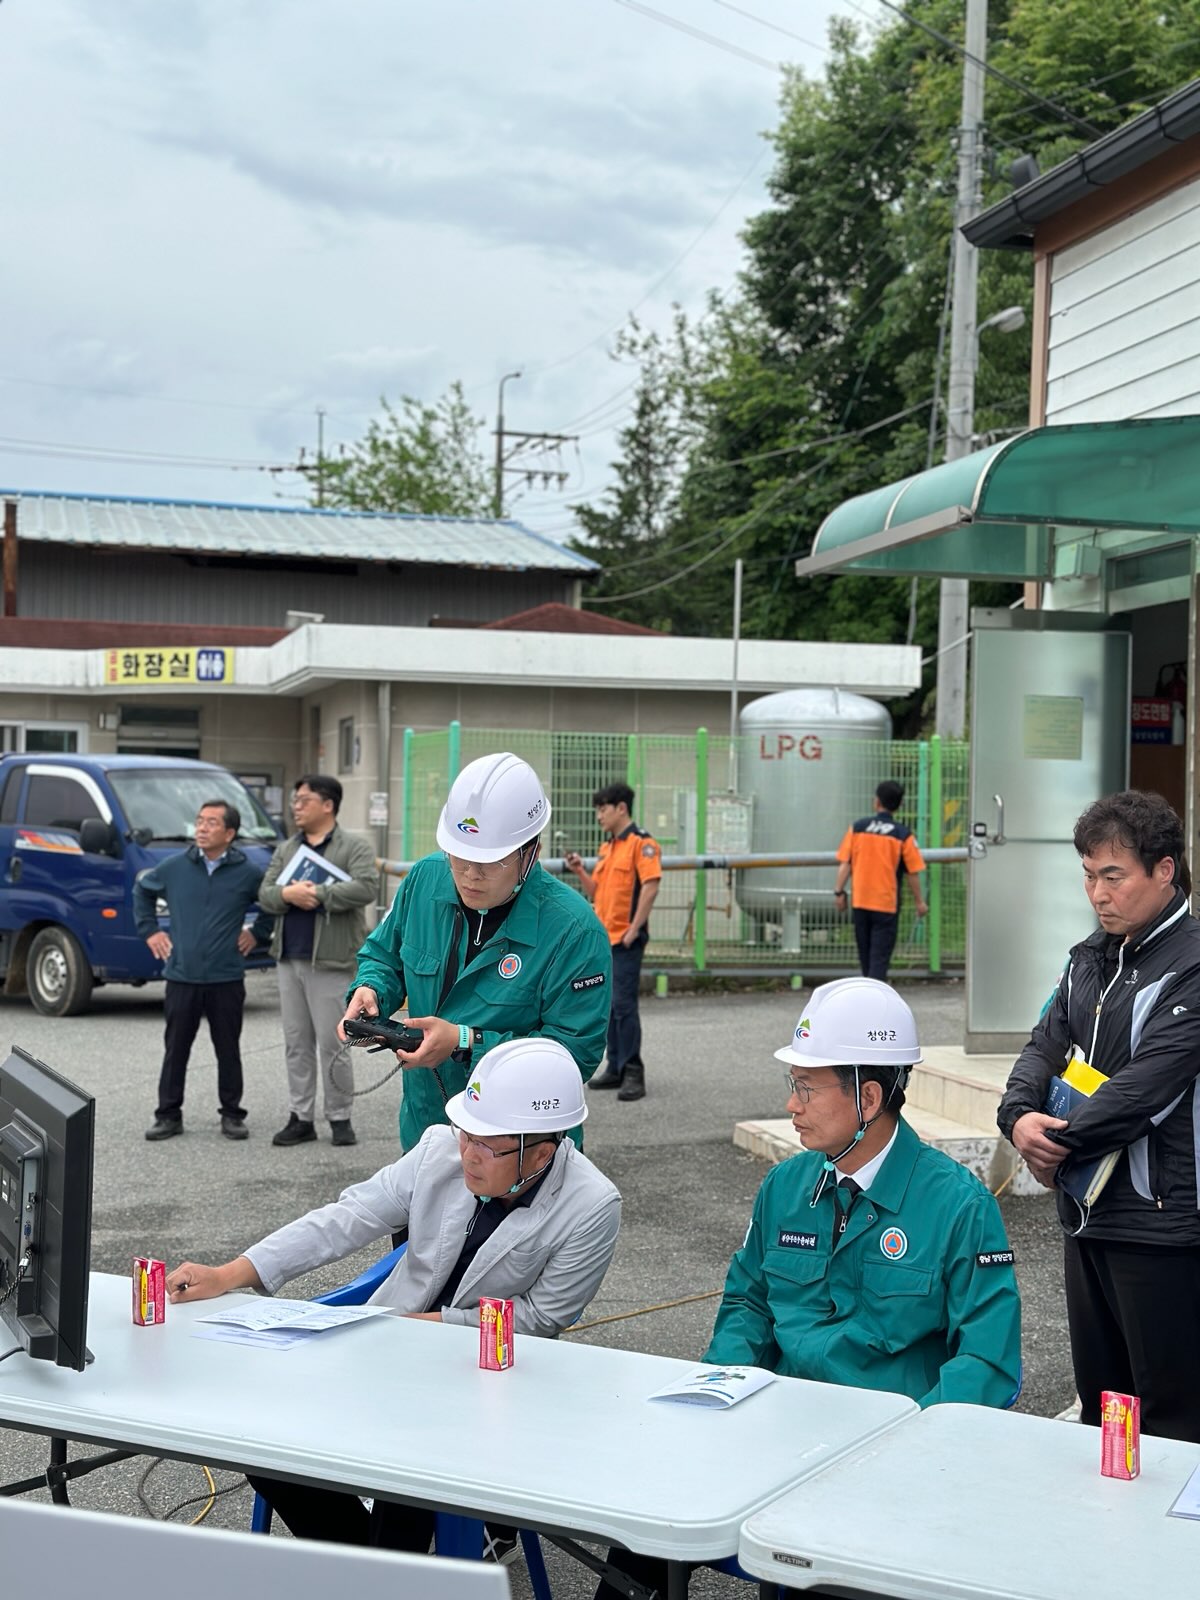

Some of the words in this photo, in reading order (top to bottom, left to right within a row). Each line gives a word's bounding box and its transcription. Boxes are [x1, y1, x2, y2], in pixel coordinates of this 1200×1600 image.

[122, 652, 190, 678] 화장실
[760, 734, 823, 760] LPG
[527, 799, 543, 819] 청양군
[867, 1030, 897, 1042] 청양군
[531, 1098, 560, 1111] 청양군
[1104, 1412, 1126, 1425] DAY
